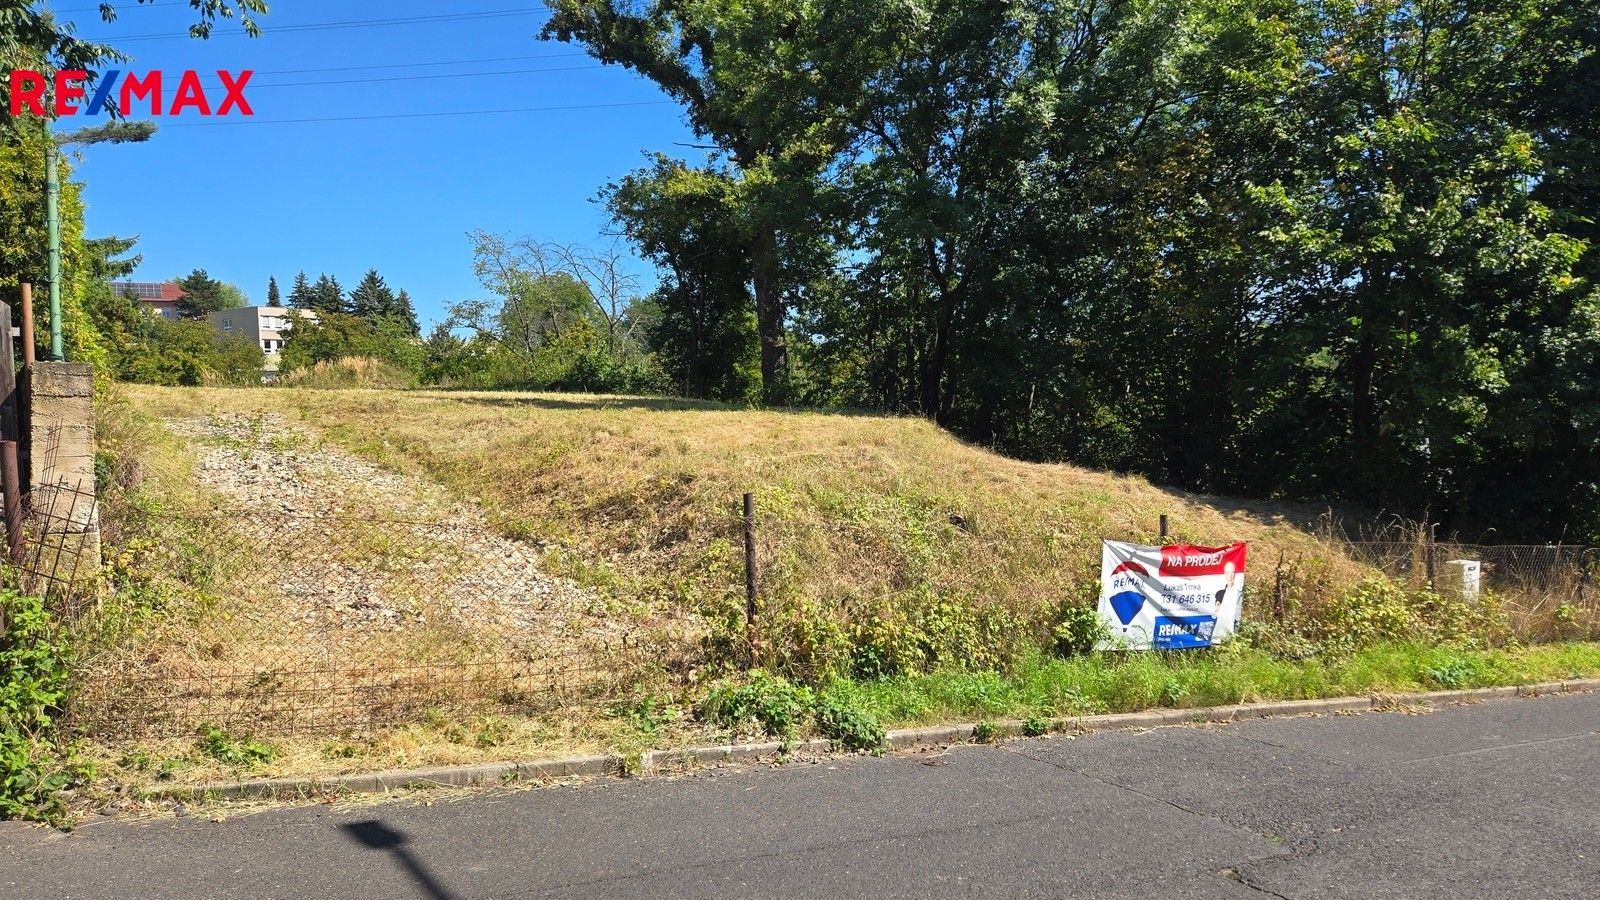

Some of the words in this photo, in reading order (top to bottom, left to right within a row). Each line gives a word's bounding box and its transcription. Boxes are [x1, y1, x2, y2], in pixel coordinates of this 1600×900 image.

[1167, 555, 1182, 567] NA
[1185, 554, 1223, 567] PRODEJ
[1161, 594, 1176, 604] 731
[1179, 594, 1194, 604] 646
[1196, 594, 1210, 604] 315
[1159, 623, 1197, 636] RE/MAX
